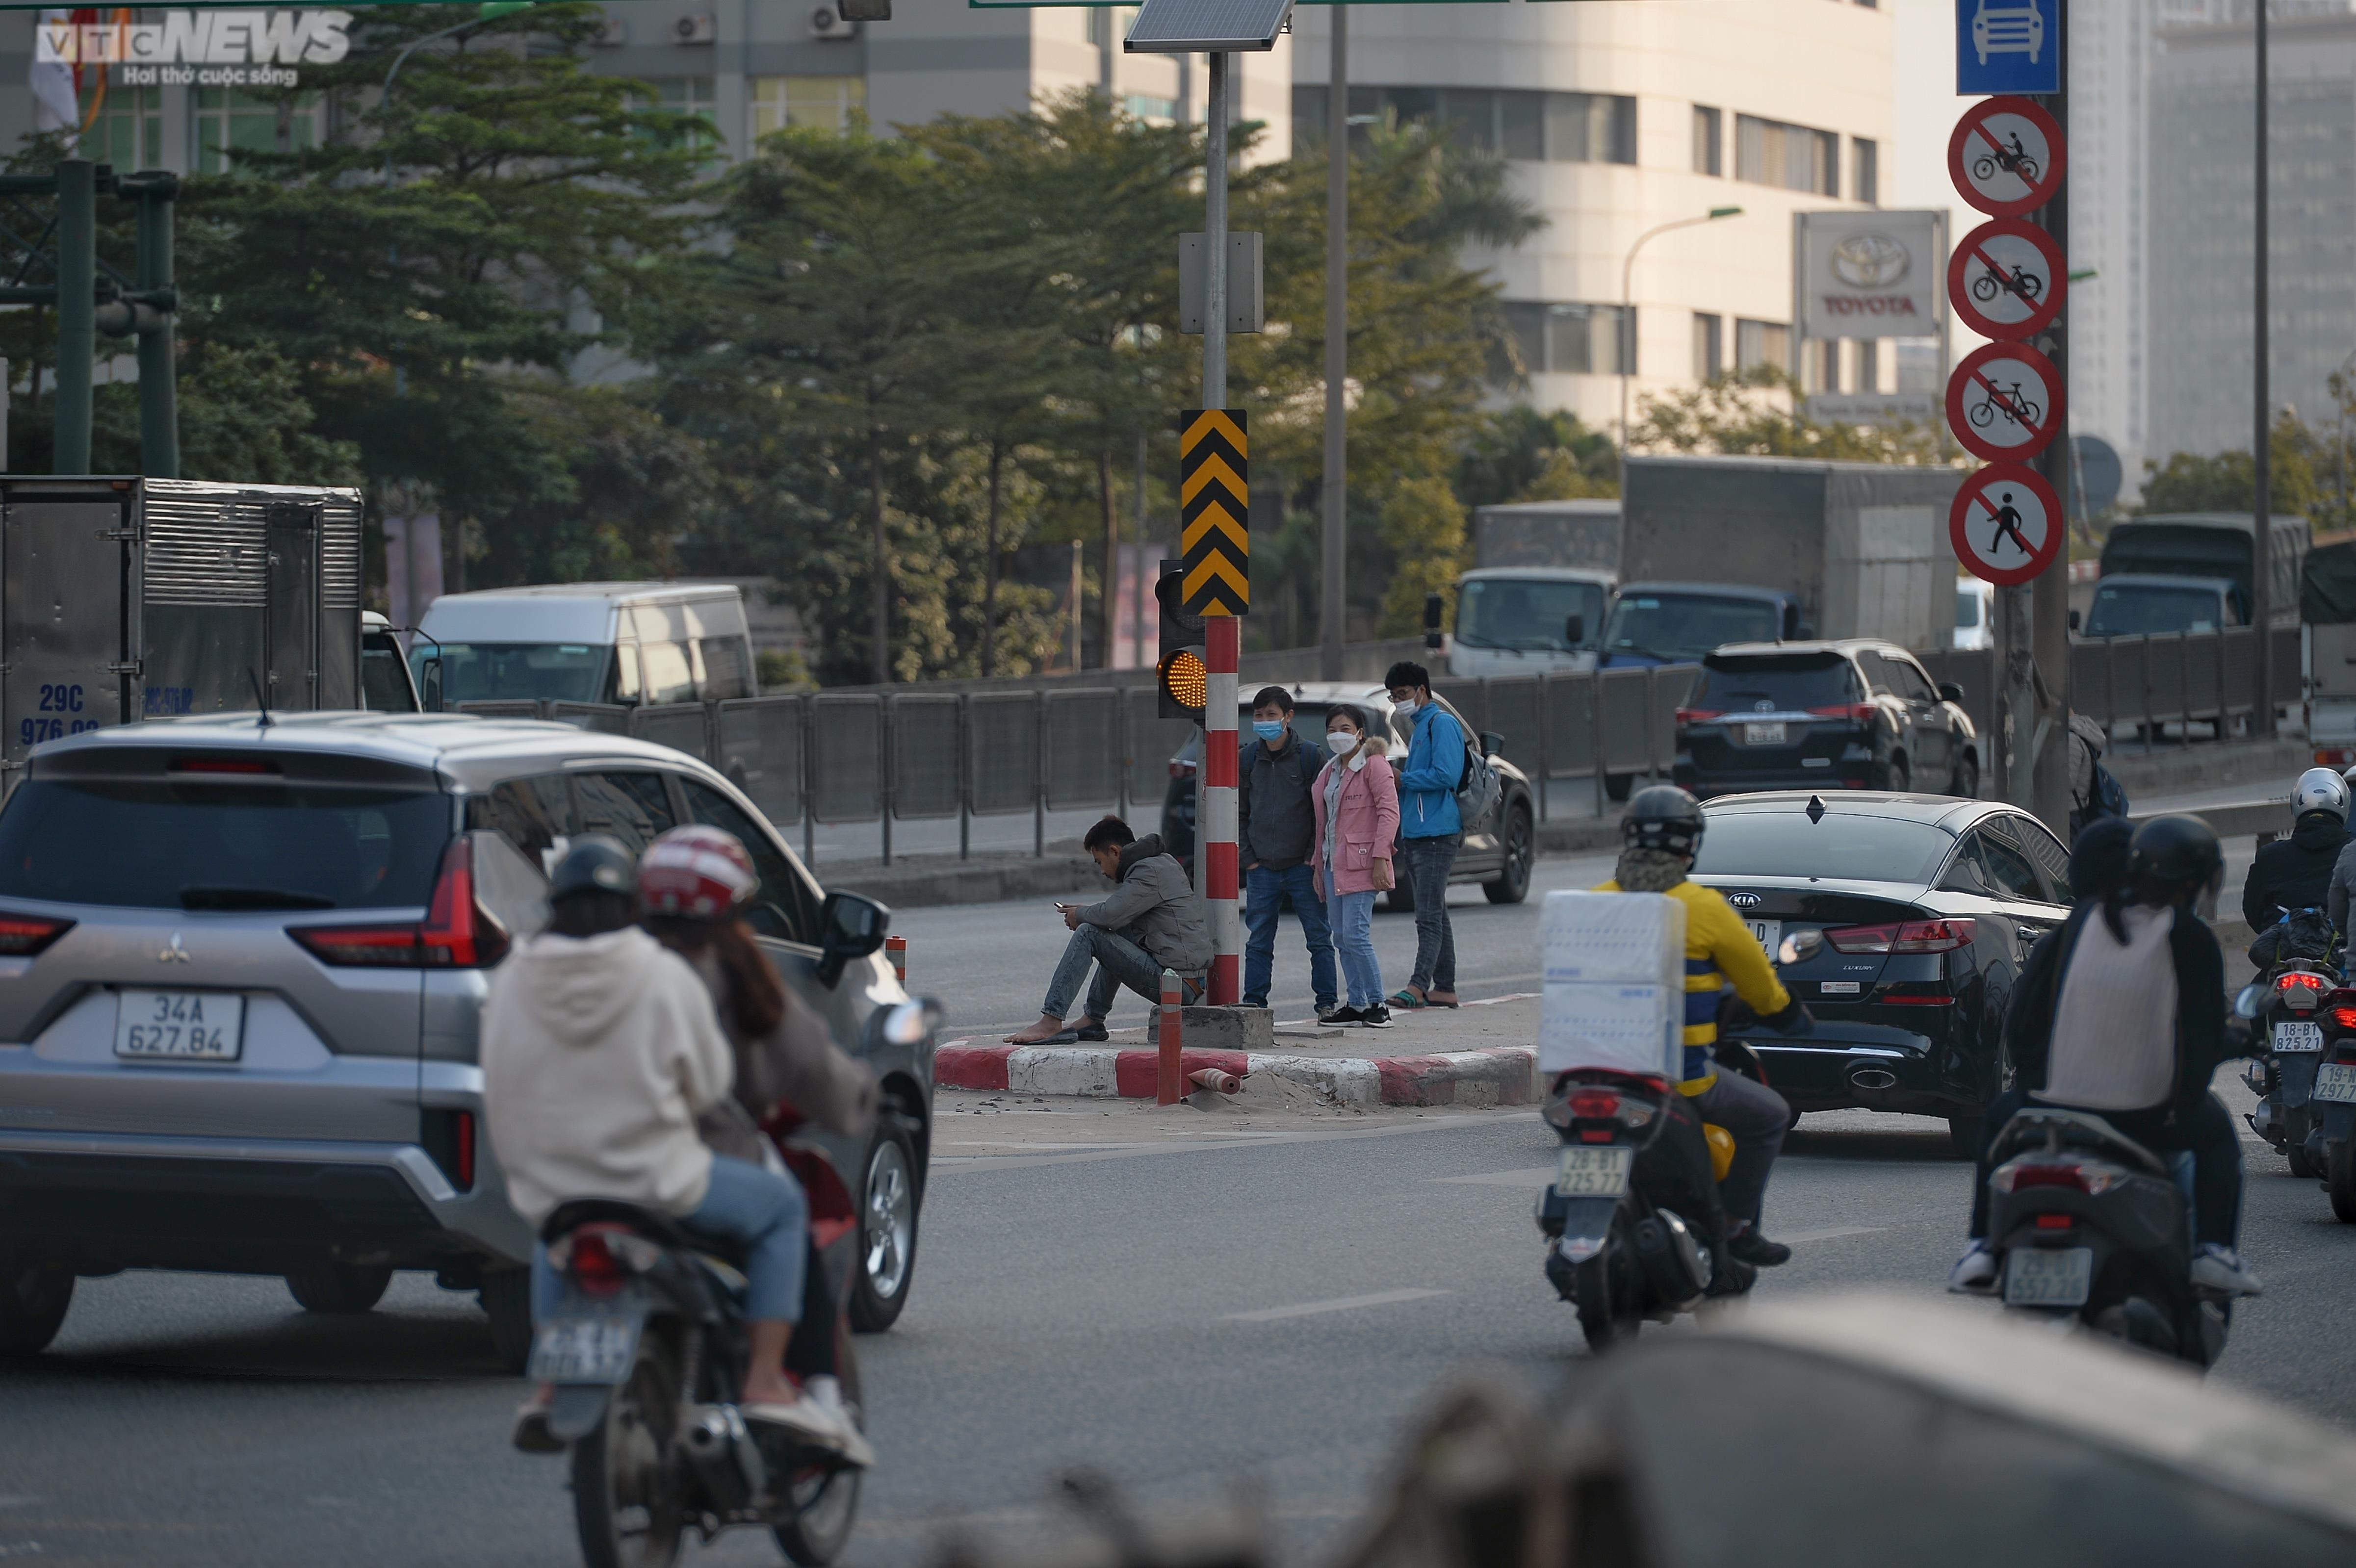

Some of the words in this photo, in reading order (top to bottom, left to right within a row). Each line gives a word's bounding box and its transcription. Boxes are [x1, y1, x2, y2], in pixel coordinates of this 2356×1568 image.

[1823, 295, 1916, 317] TOYOTA
[39, 683, 83, 712] 29C
[1734, 895, 1755, 906] KIA
[154, 995, 204, 1023] 34A
[128, 1024, 222, 1053] 627.84
[2283, 1023, 2317, 1036] 18-B1
[2276, 1036, 2320, 1050] 825.21
